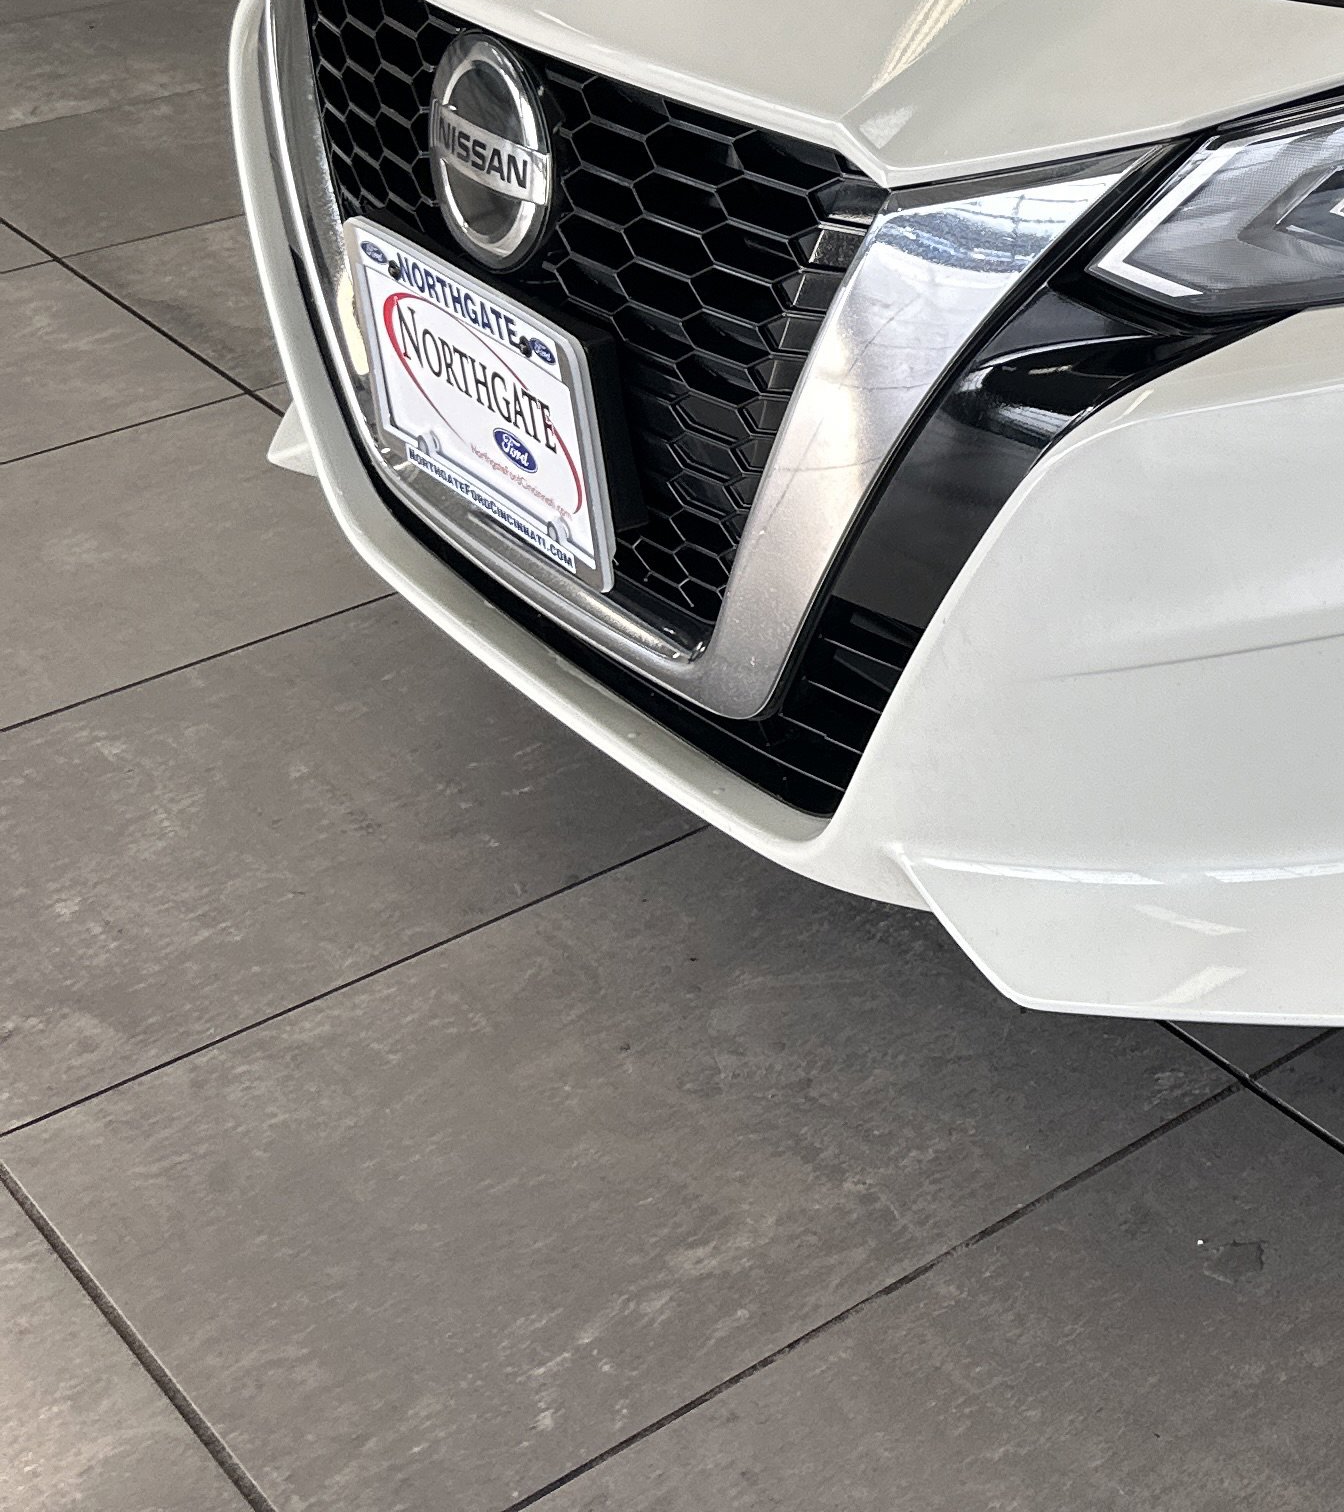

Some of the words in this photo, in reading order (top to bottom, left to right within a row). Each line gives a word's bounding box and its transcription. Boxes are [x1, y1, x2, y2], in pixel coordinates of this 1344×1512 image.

[438, 114, 530, 191] NISSAN
[397, 253, 519, 346] NORTHGATE
[396, 300, 557, 454] NORTHGATE
